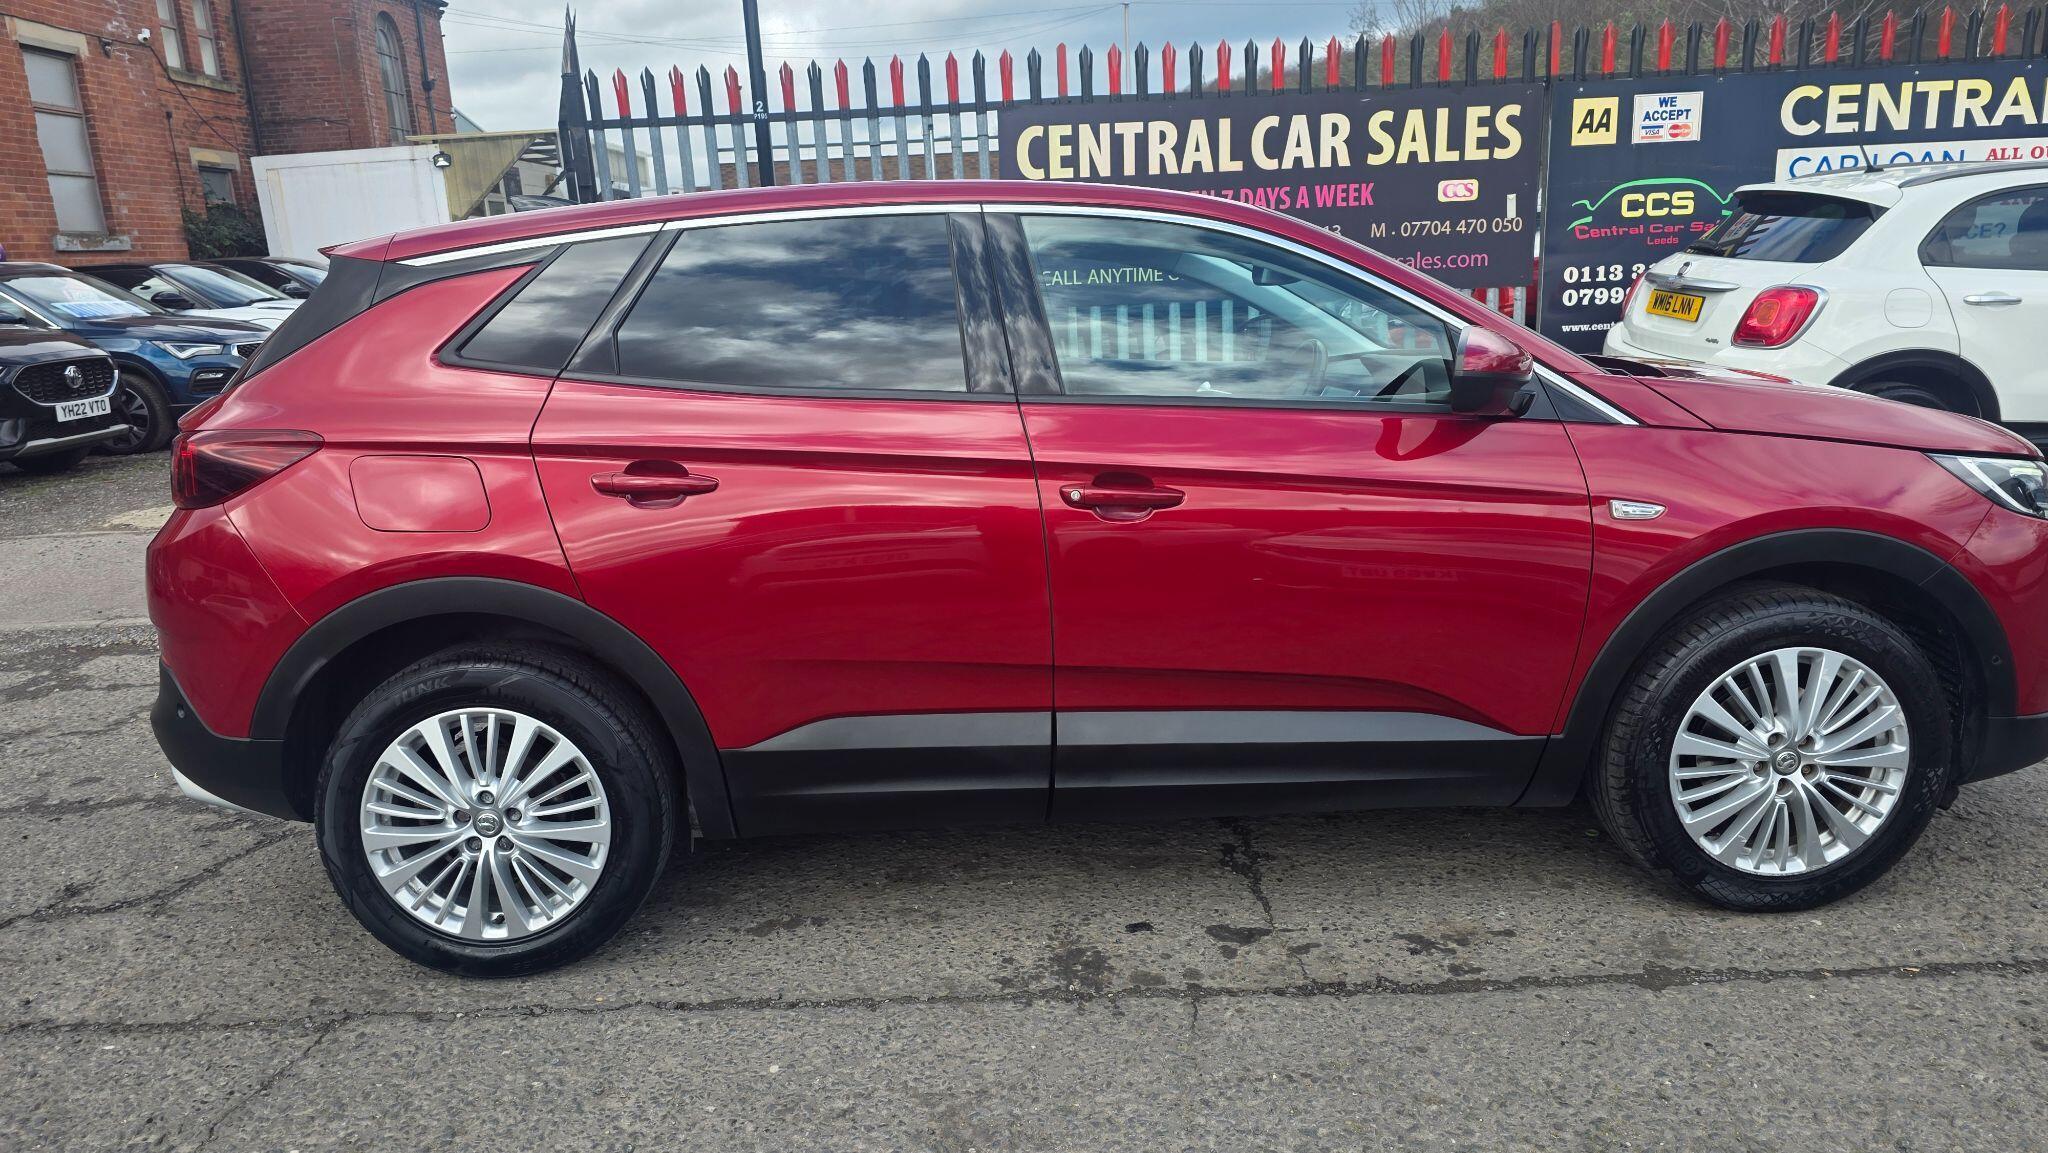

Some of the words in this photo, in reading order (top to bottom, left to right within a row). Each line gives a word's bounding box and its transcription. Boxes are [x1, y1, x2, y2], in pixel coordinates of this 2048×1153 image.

[755, 100, 764, 112] 2
[1658, 96, 1678, 108] WE
[1577, 107, 1612, 134] AA
[1643, 108, 1692, 122] ACCEPT
[1016, 117, 1244, 181] CENTRAL
[1251, 112, 1352, 171] CAR
[1367, 103, 1523, 166] SALES
[1985, 146, 2024, 162] ALL
[1240, 185, 1291, 210] DAYS
[1296, 185, 1310, 209] A
[1315, 182, 1375, 208] WEEK
[1442, 182, 1475, 199] CCS
[1621, 190, 1695, 218] CCS
[1370, 222, 1386, 239] M
[1401, 220, 1451, 237] 07704
[1456, 218, 1487, 235] 470
[1492, 216, 1523, 233] 050
[1574, 223, 1644, 240] Central
[1650, 222, 1685, 234] Car
[1690, 219, 1720, 233] Sa
[1647, 236, 1679, 246] Leeds
[1043, 269, 1083, 286] CALL
[1087, 267, 1164, 285] ANYTIME
[1563, 264, 1624, 284] 0113
[1562, 286, 1632, 307] 0799
[1672, 295, 1695, 316] LNN
[61, 402, 87, 418] YH22
[88, 400, 107, 414] VTO
